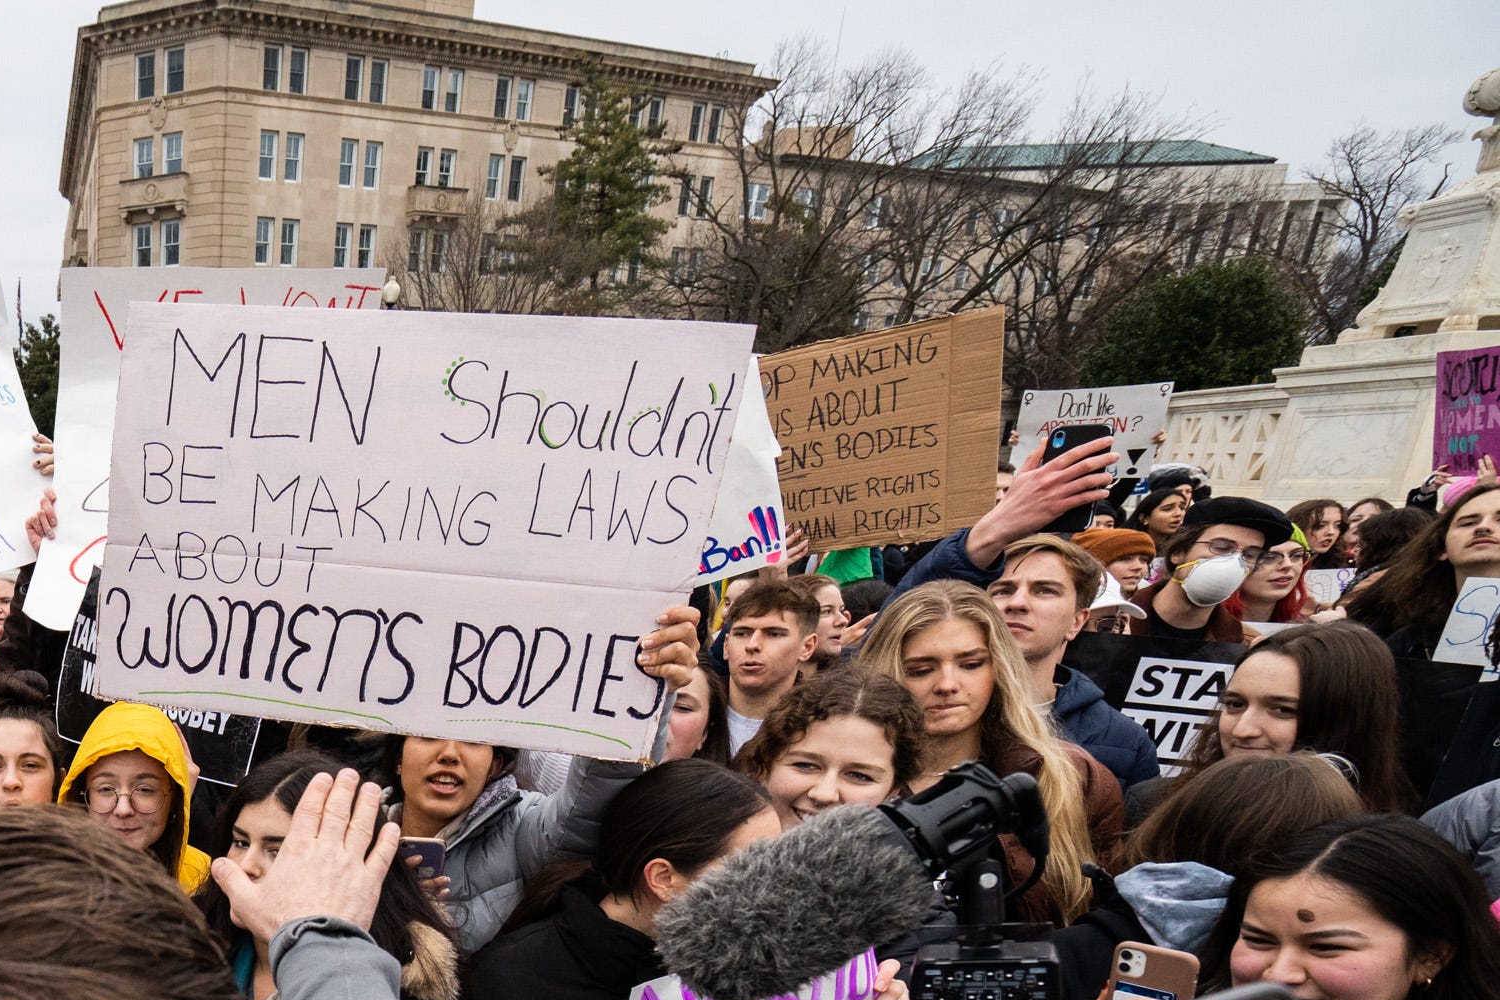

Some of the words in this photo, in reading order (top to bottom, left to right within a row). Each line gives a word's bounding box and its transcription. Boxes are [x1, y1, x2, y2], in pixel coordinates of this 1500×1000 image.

[808, 332, 939, 390] MAKING
[166, 327, 381, 446] MEN
[440, 359, 734, 474] Shouldn't
[806, 377, 909, 432] ABOUT
[1058, 392, 1093, 419] Don't
[1096, 393, 1116, 416] like
[836, 423, 939, 460] BODIES
[1447, 434, 1480, 456] NOT
[143, 441, 224, 505] BE
[251, 473, 498, 546] MAKING
[527, 462, 698, 546] LAWS
[865, 469, 941, 498] RIGHTS
[853, 502, 942, 533] RIGHTS
[128, 531, 334, 593] ABOUT
[443, 620, 667, 720] BODIES
